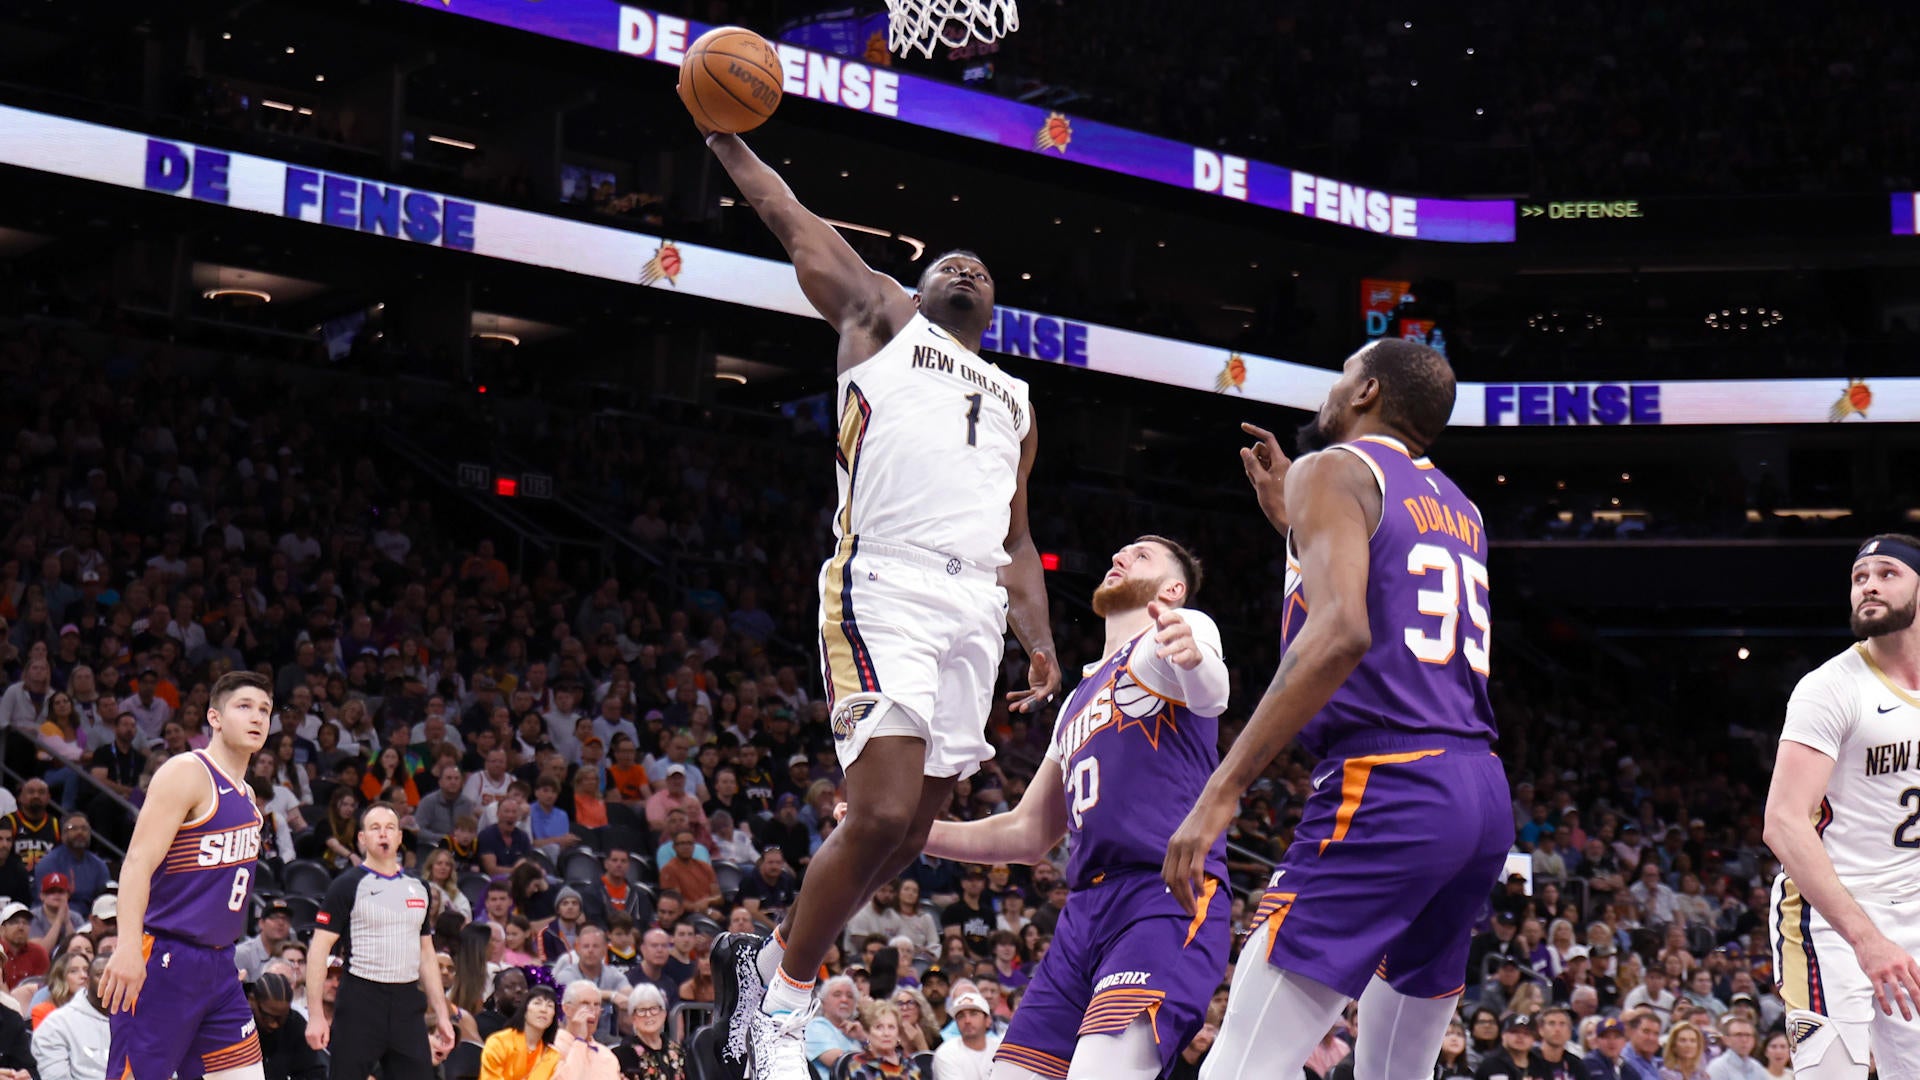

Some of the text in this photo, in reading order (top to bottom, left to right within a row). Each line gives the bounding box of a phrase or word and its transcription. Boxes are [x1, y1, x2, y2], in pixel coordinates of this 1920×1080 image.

[619, 6, 685, 64] DE
[729, 61, 778, 110] Wilson
[144, 138, 475, 252] DE FENSE
[1194, 149, 1418, 237] DE FENSE
[981, 308, 1088, 367] ENSE
[911, 345, 1024, 431] NEW ORLEANS
[1484, 384, 1662, 425] FENSE
[964, 391, 982, 448] 1
[1403, 495, 1480, 553] DURANT
[1404, 542, 1491, 678] 35
[1865, 740, 1911, 777] NEW
[198, 826, 260, 867] SUNS
[228, 867, 251, 912] 8
